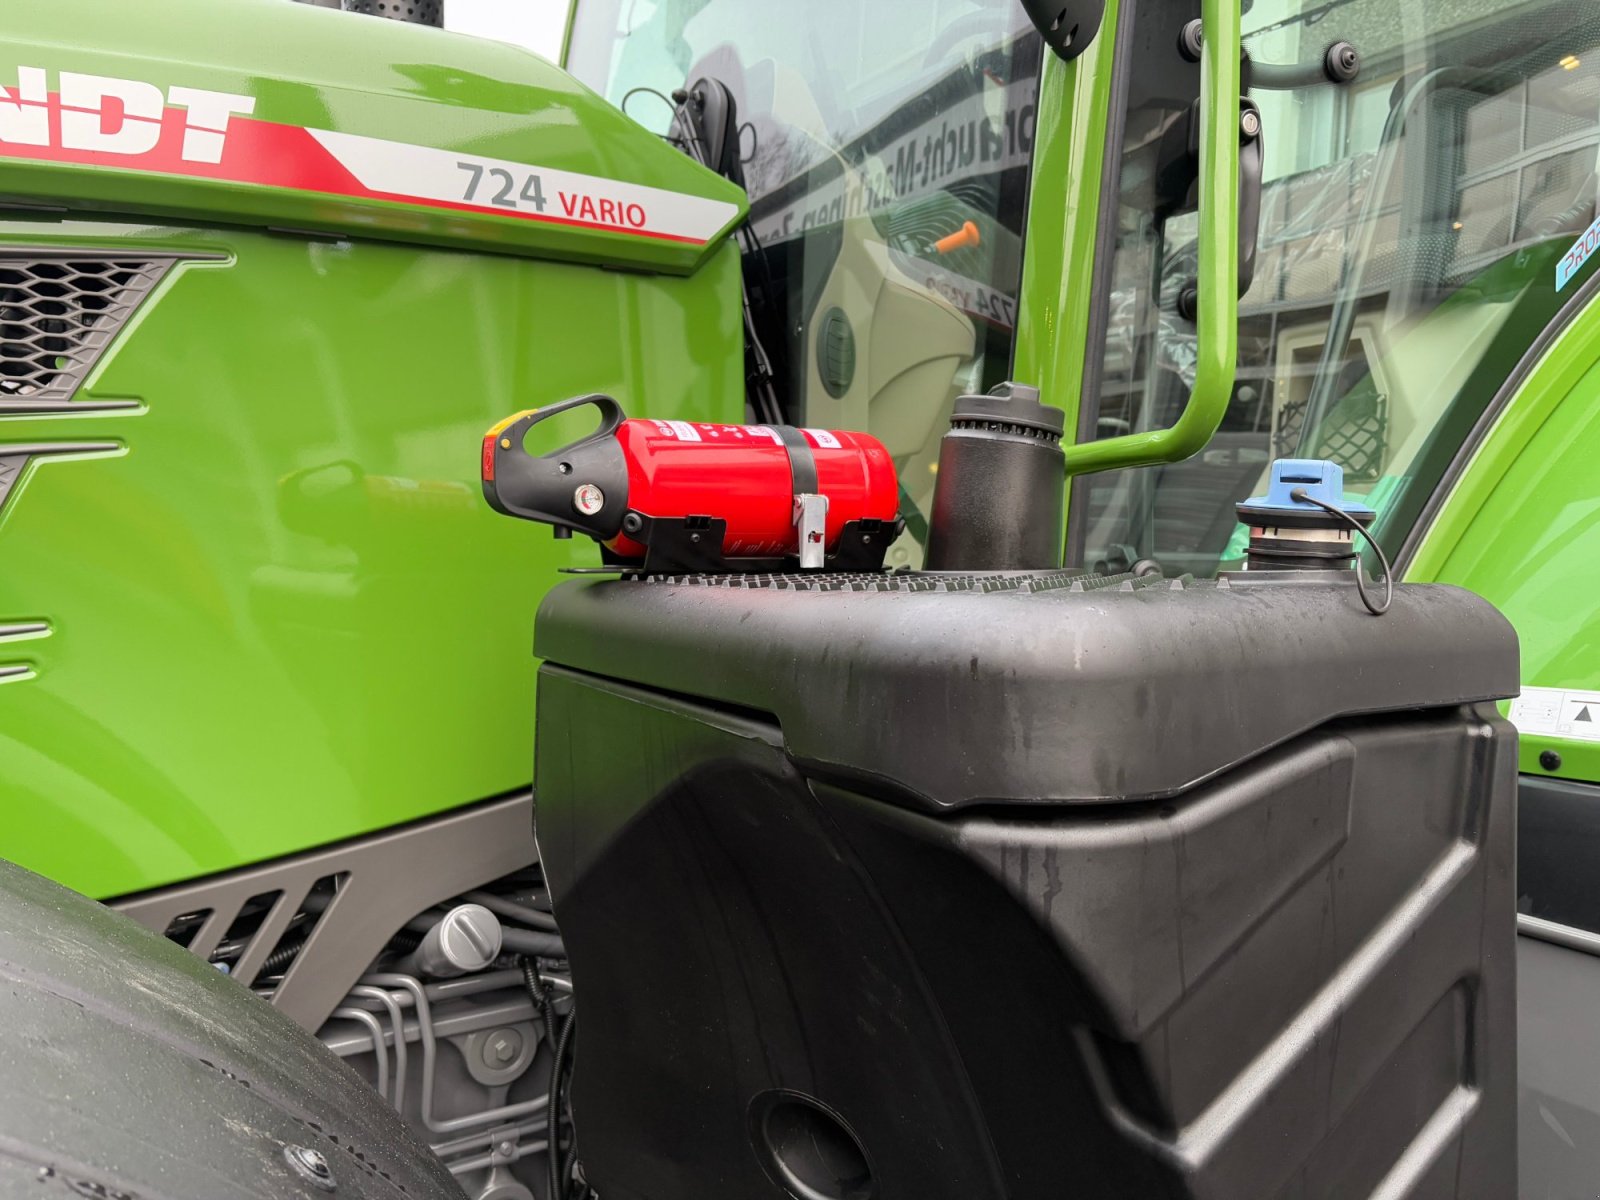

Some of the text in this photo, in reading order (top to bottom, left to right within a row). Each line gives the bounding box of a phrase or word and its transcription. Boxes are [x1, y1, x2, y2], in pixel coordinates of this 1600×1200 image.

[456, 161, 646, 228] 724 VARIO
[1564, 223, 1600, 278] PRO
